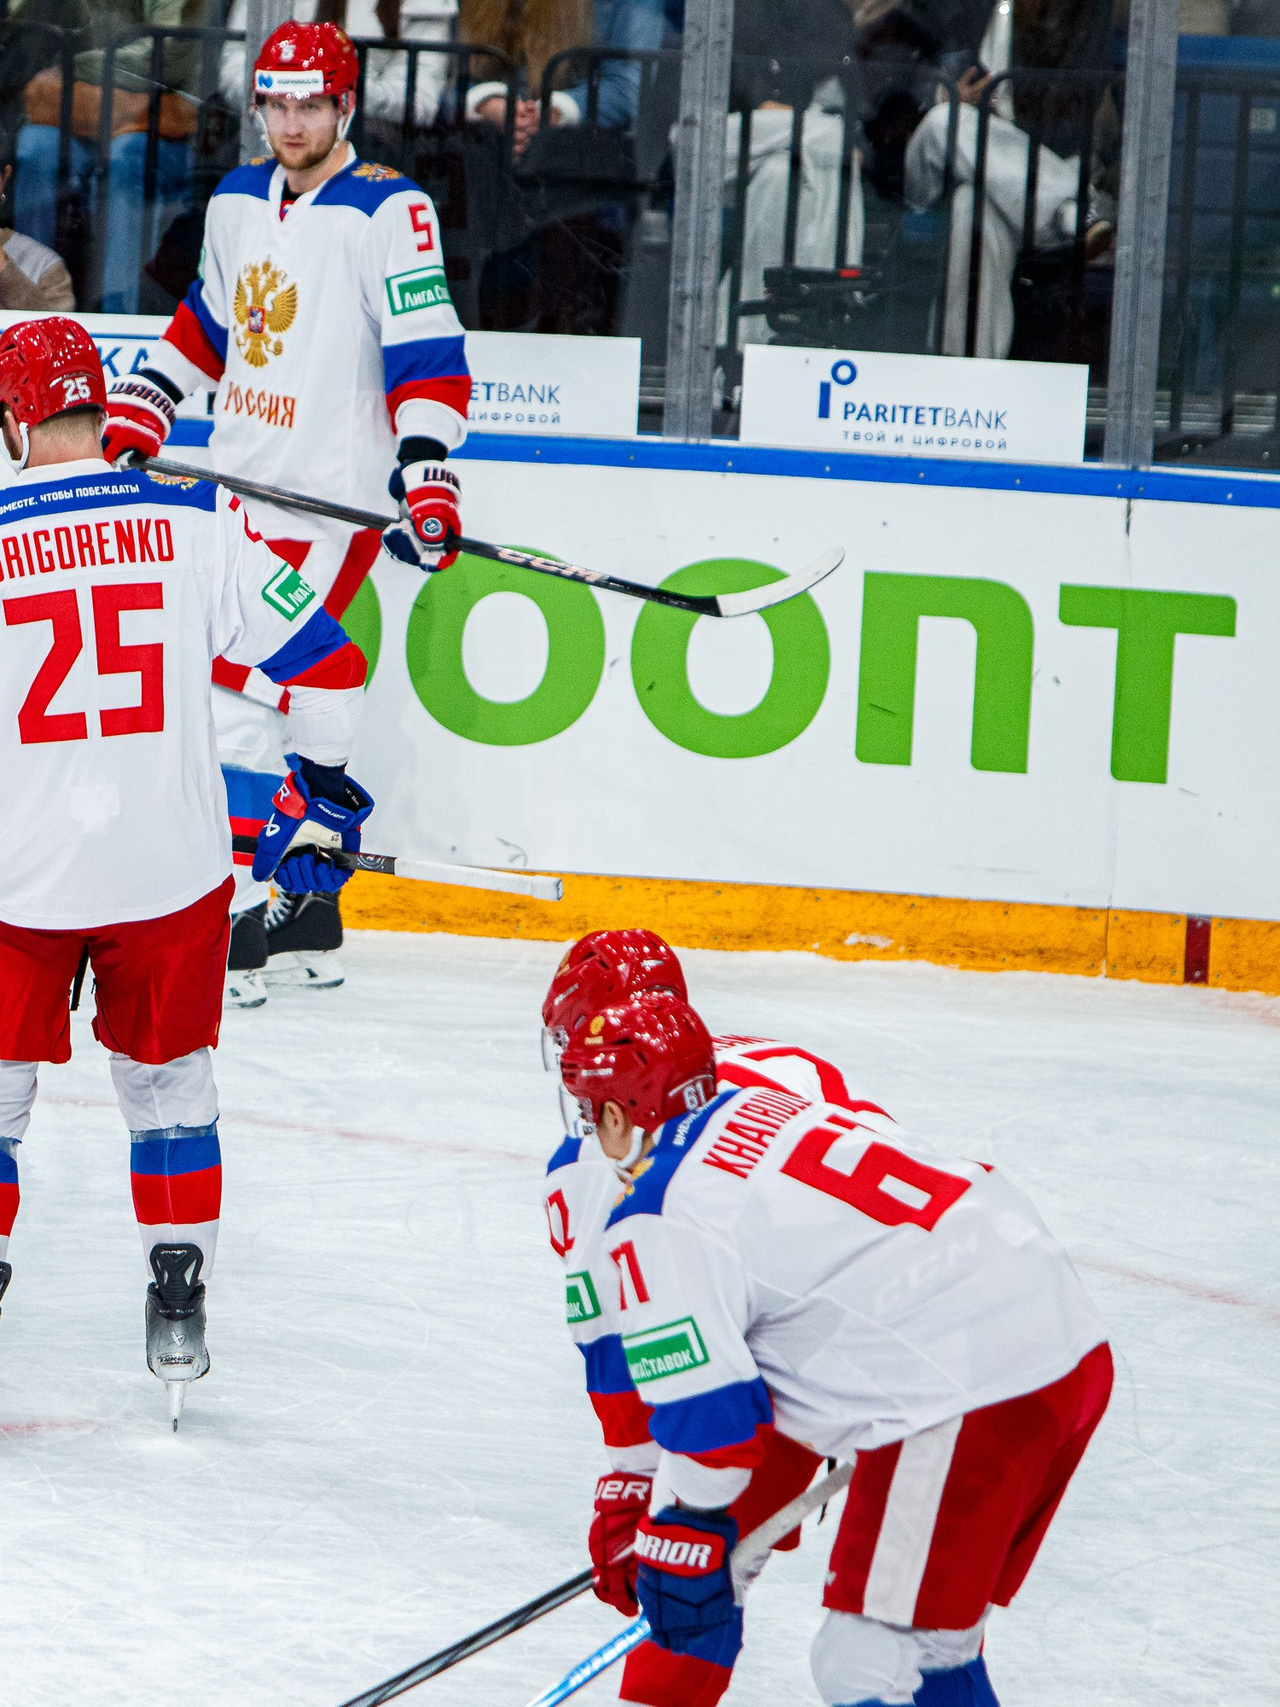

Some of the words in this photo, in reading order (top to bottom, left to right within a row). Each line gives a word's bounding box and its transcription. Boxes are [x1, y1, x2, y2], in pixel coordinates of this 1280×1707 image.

[407, 202, 434, 252] 5
[62, 376, 91, 402] 25
[843, 401, 1008, 430] PARITETBANK
[843, 430, 886, 443] ТВОЙ
[895, 434, 904, 443] И
[913, 435, 1007, 449] ЦИФРОВОЙ
[40, 490, 73, 504] ЧТОБЫ
[2, 581, 165, 745] 25
[683, 1081, 706, 1111] 61
